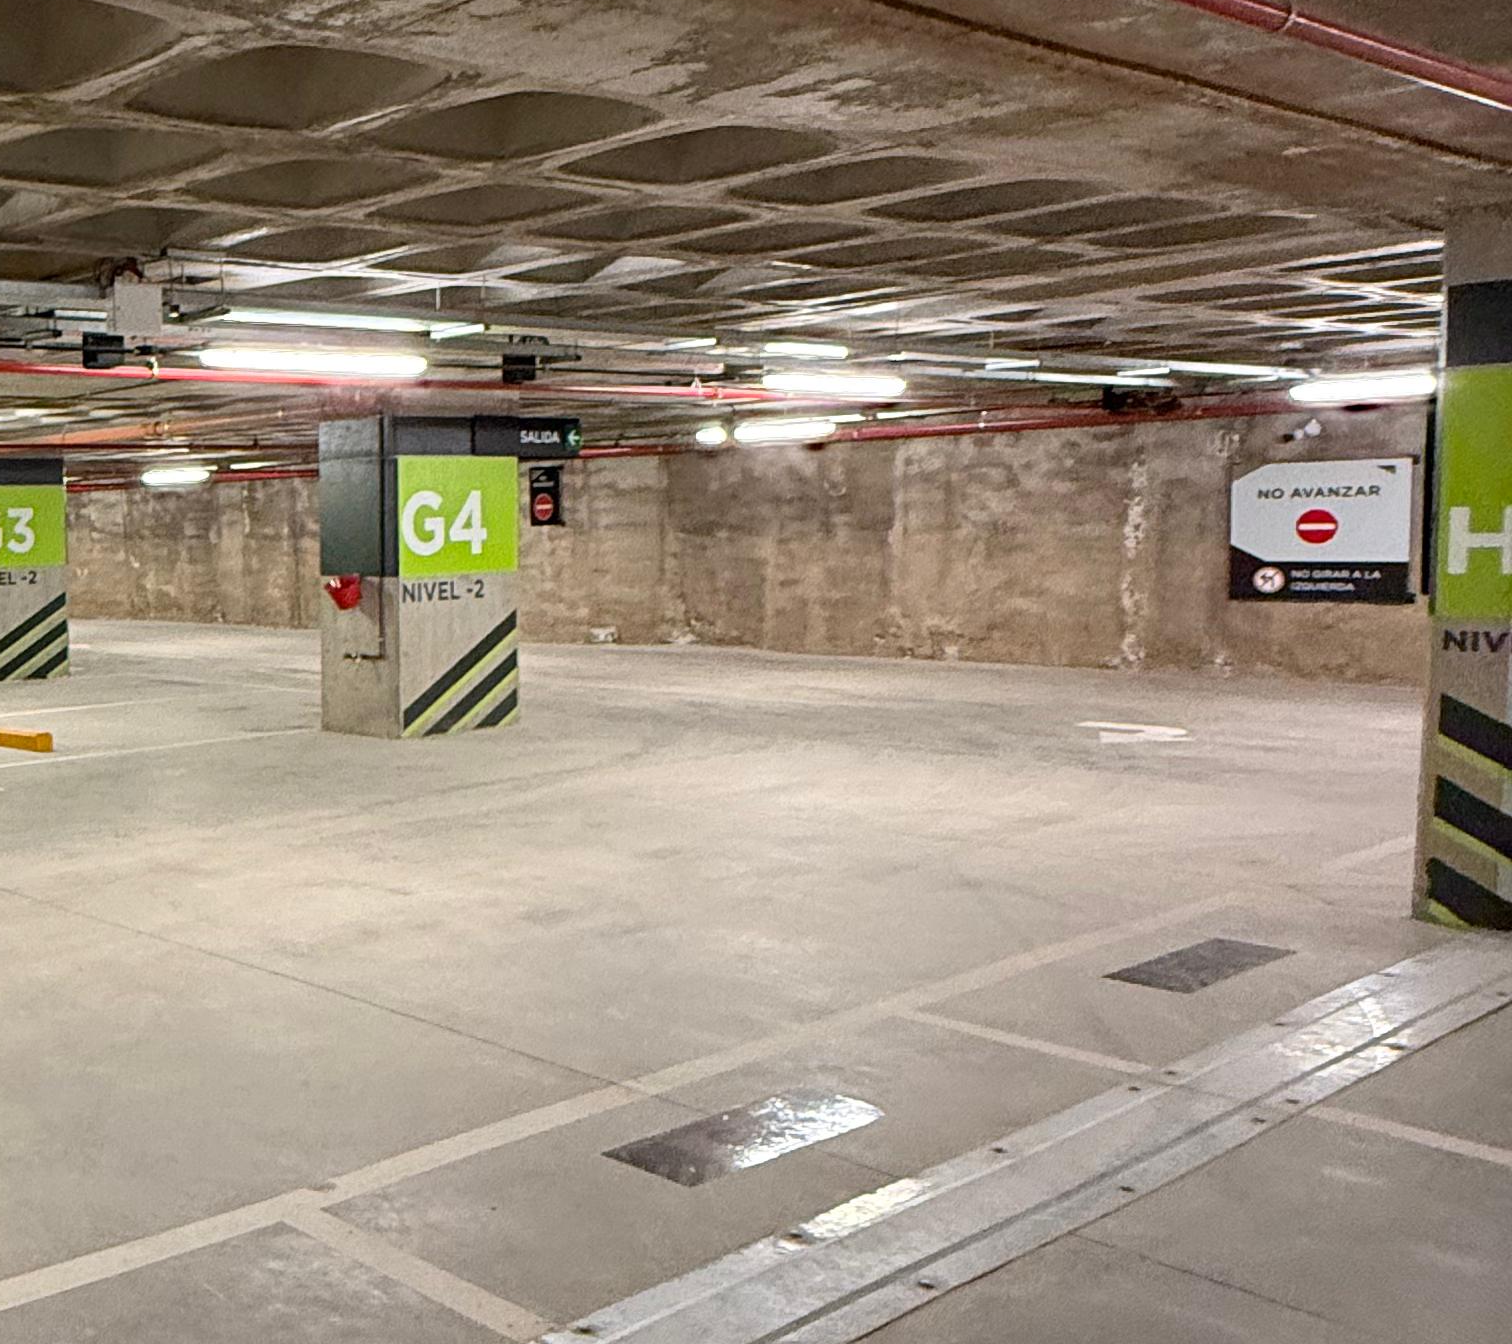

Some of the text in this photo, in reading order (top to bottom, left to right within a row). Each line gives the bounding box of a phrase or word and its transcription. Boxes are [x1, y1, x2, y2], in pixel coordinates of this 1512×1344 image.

[520, 430, 560, 443] SALIDA
[1257, 485, 1381, 499] NO AVANZAR
[402, 490, 487, 556] G4
[21, 570, 37, 585] -2
[1352, 569, 1362, 578] A
[1364, 570, 1381, 579] LA
[402, 579, 486, 603] NIVEL -2
